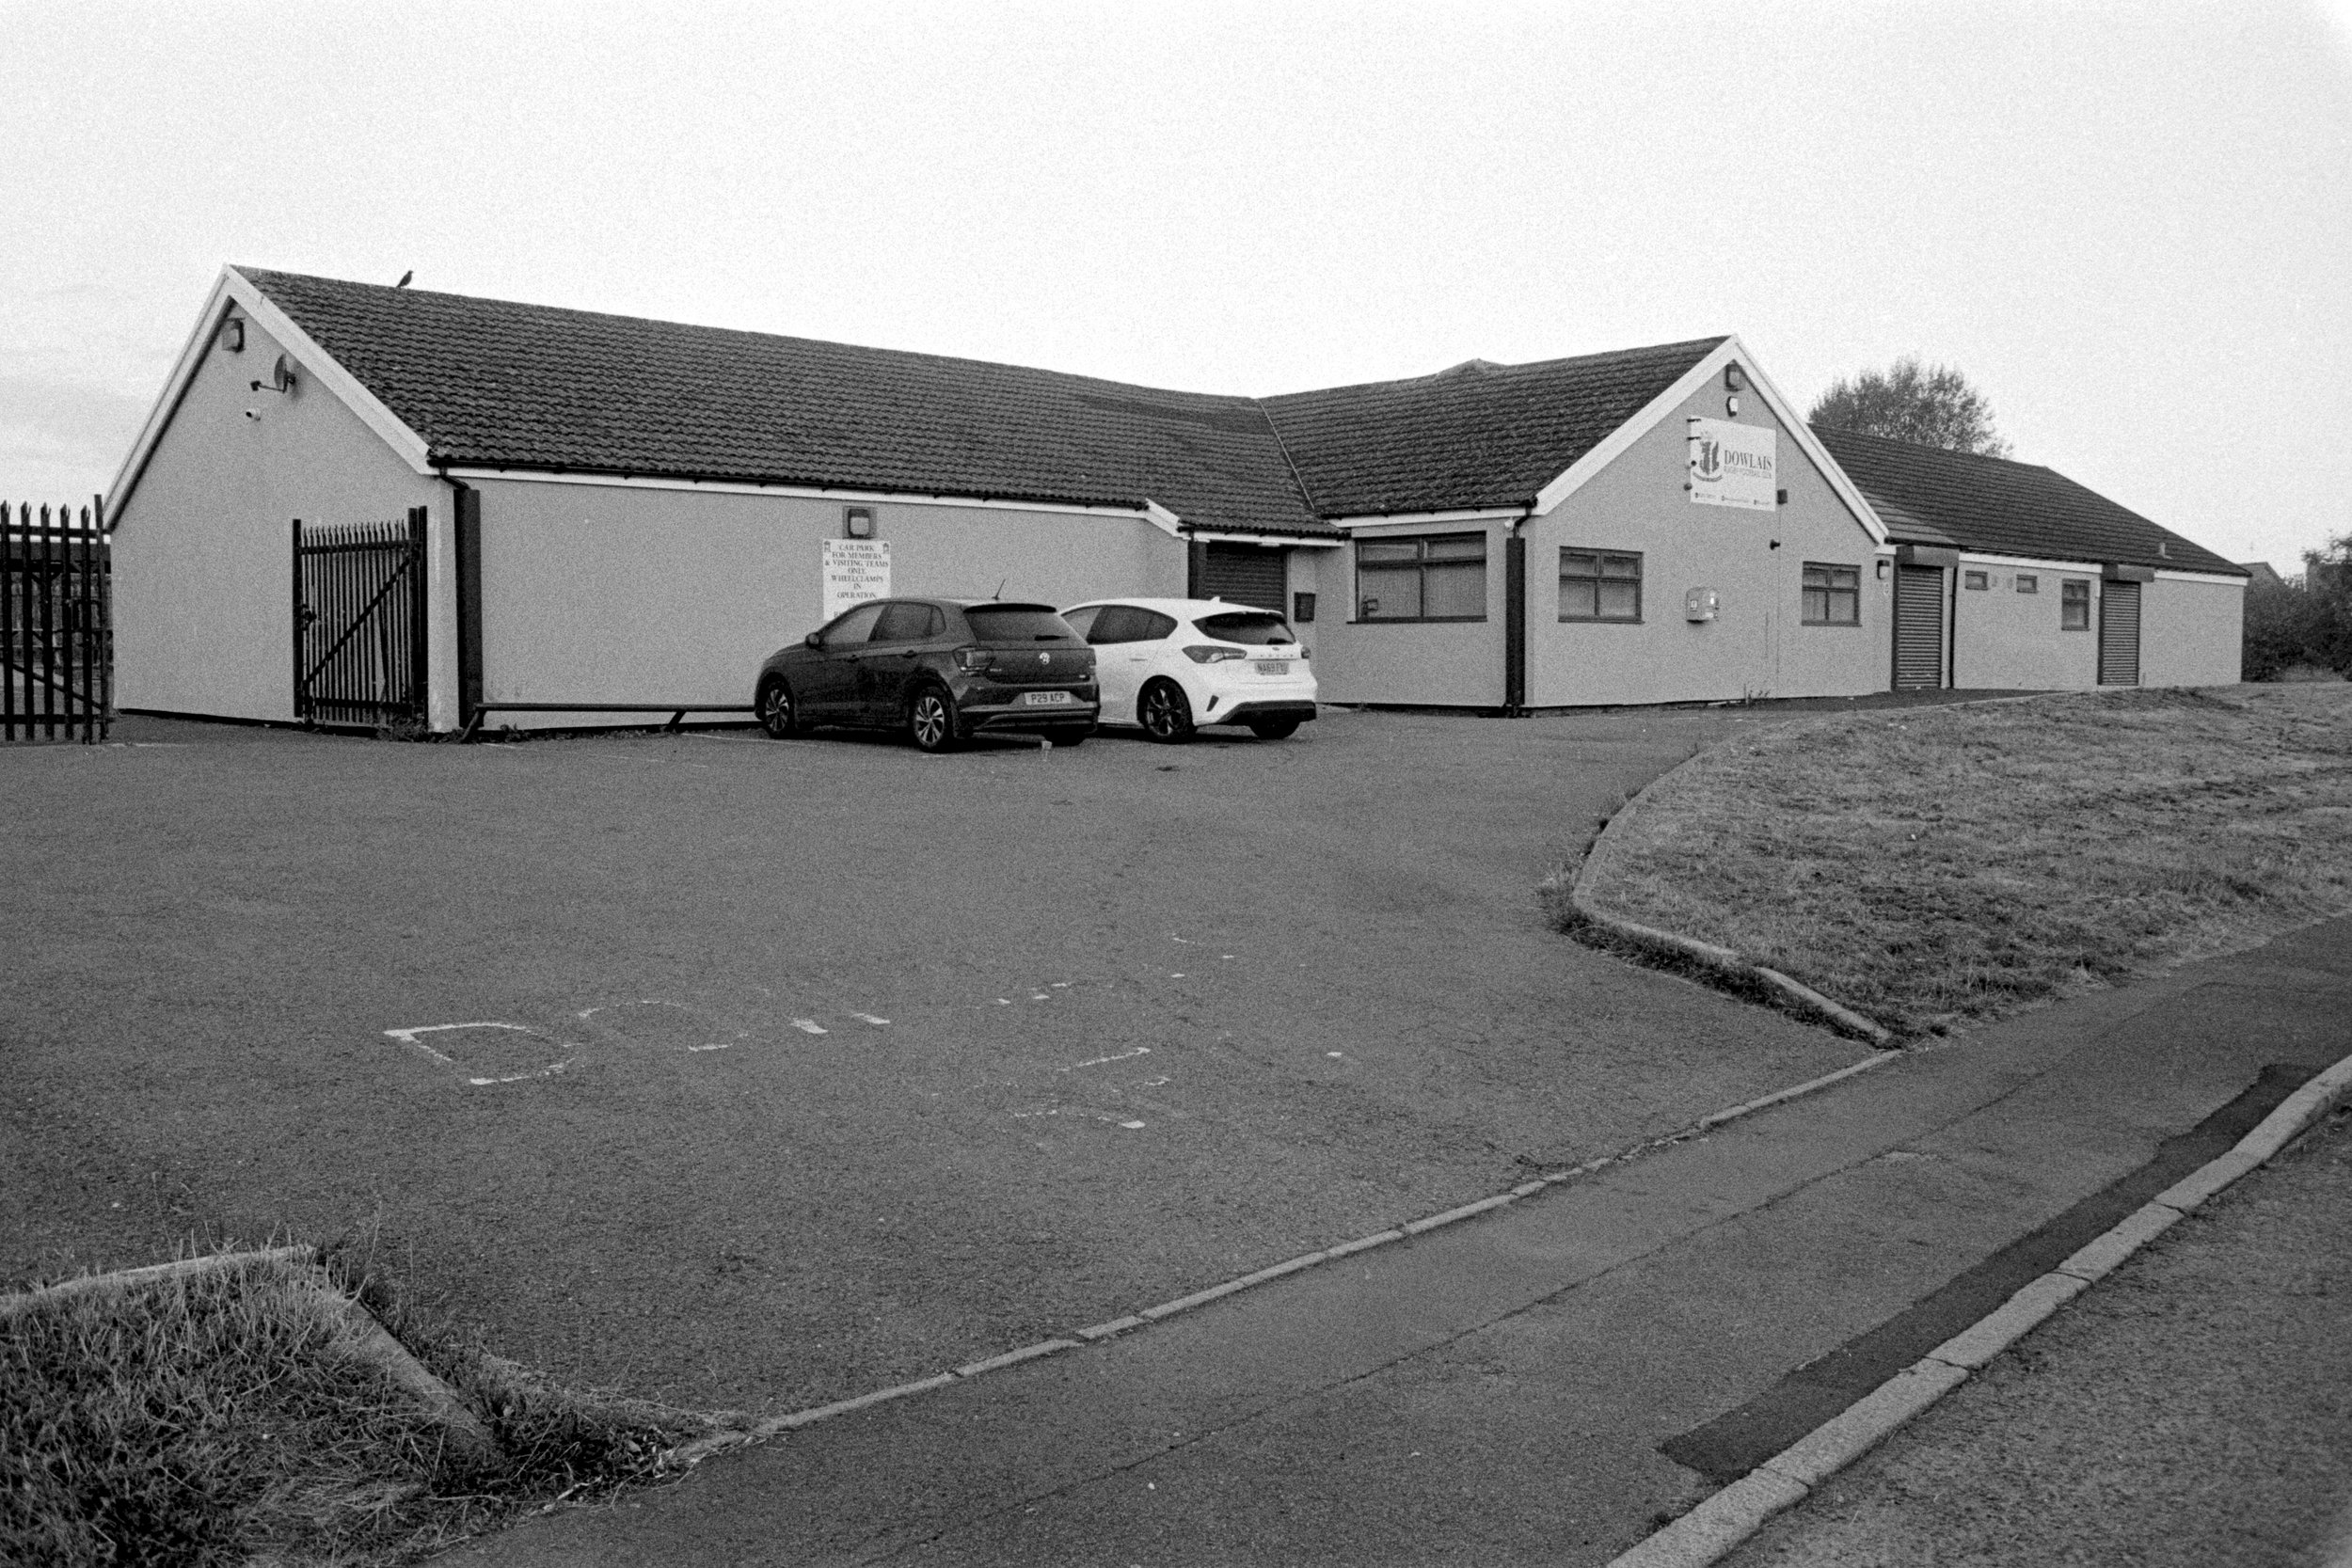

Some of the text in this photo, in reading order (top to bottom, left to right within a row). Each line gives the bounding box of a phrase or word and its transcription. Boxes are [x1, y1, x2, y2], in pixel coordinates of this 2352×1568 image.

[1724, 450, 1772, 470] DOWLAIS
[848, 551, 882, 560] MEMBERS
[866, 560, 889, 568] TEAMS
[831, 574, 884, 582] WHEELCLAMPS
[836, 591, 877, 599] OPERATION
[1030, 692, 1065, 704] P29 ACP
